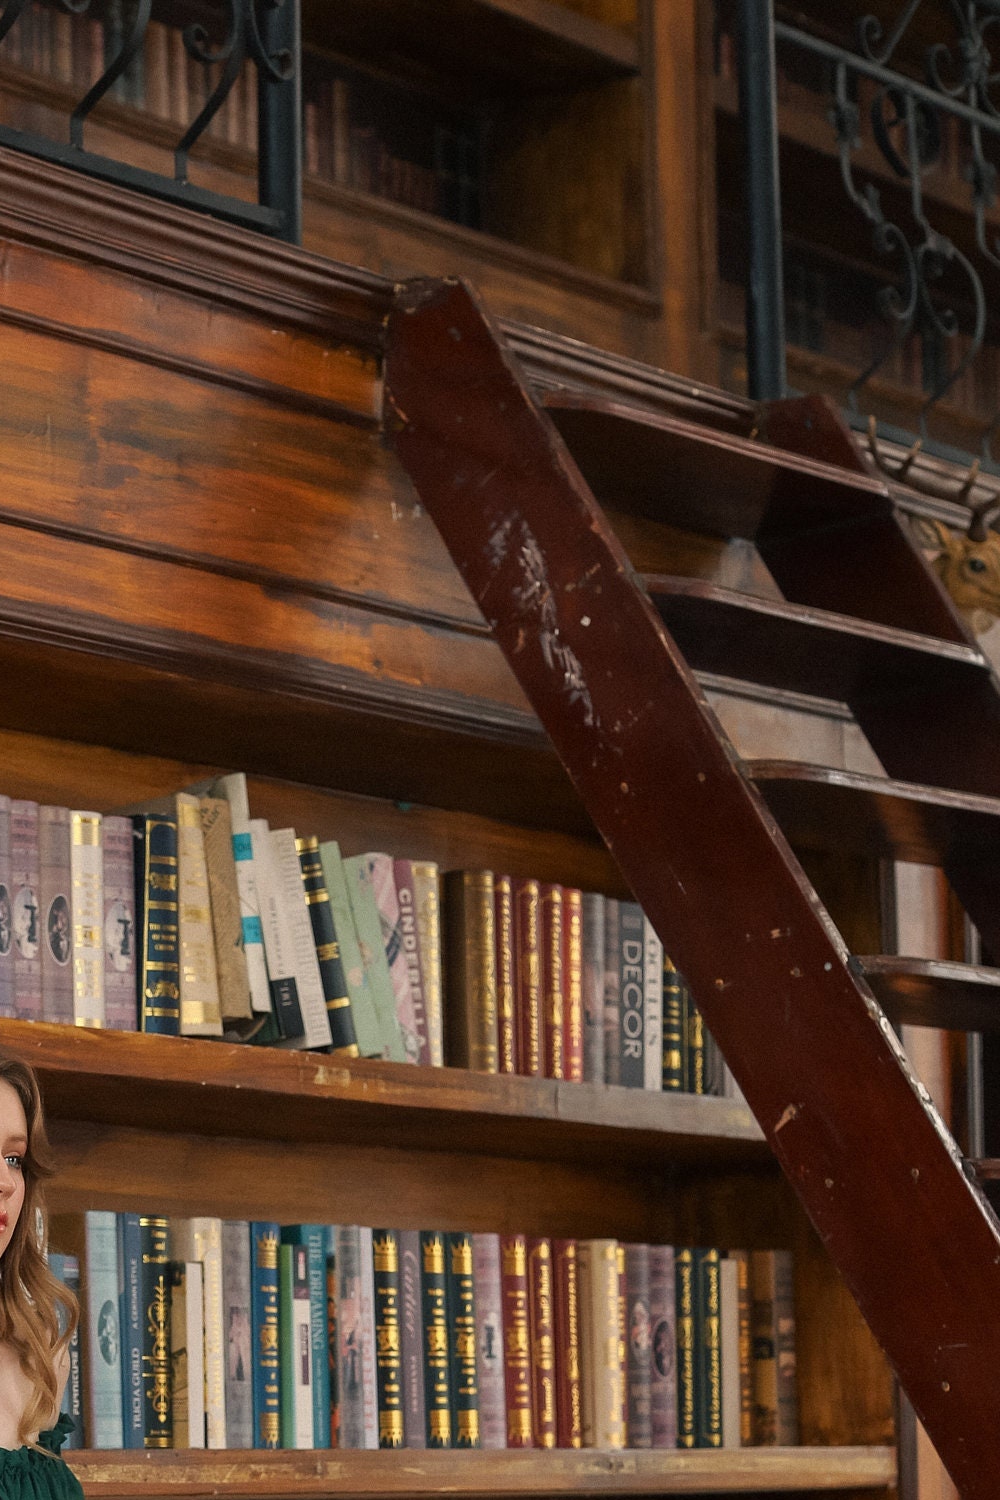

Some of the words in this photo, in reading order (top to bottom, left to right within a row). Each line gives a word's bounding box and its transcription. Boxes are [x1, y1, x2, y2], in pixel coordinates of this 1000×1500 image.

[622, 939, 643, 1059] DECOR
[308, 1234, 322, 1265] THE
[310, 1269, 324, 1350] DREAMING
[131, 1348, 141, 1386] GUILD
[132, 1388, 141, 1429] TRICIA
